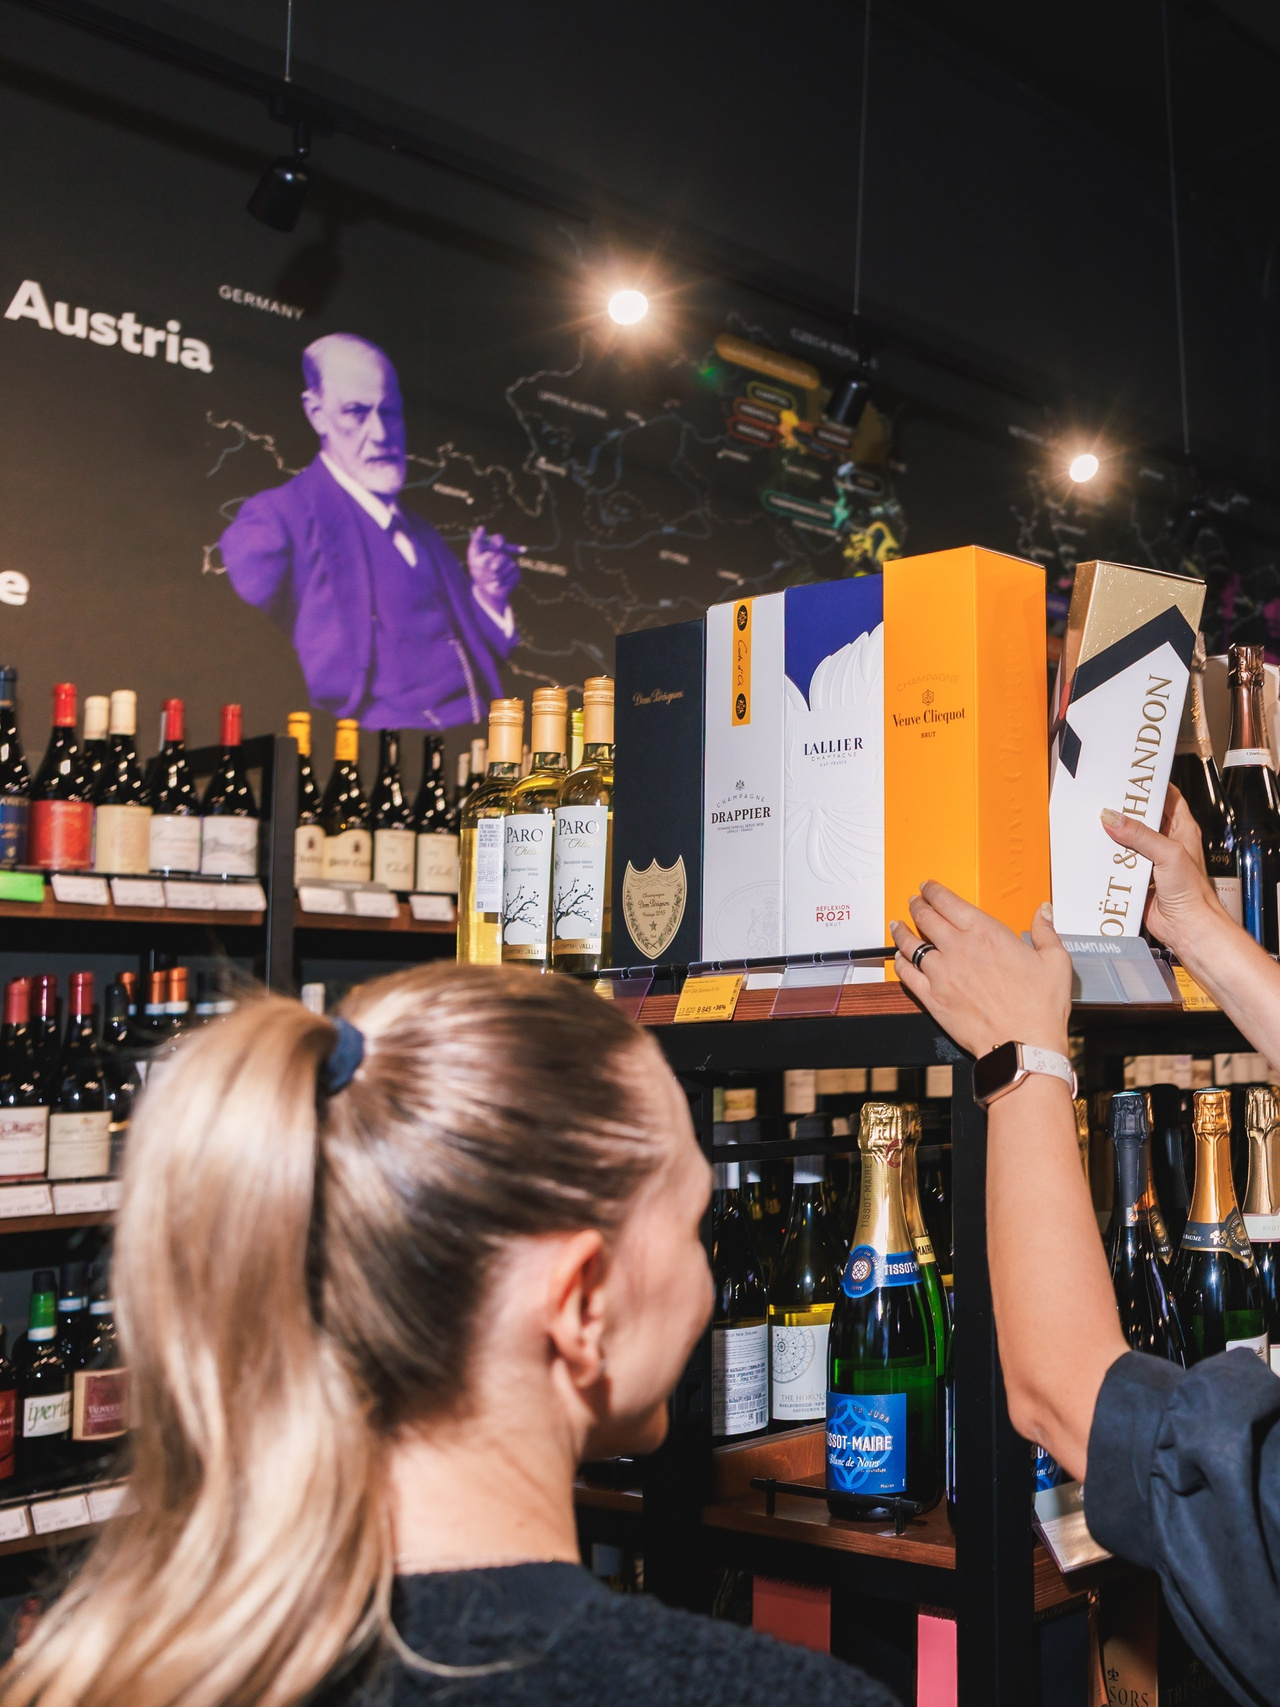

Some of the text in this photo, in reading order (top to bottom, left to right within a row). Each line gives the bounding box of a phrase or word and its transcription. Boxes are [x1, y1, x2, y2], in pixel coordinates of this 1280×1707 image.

[218, 284, 305, 320] GERMANY
[4, 279, 213, 374] Austria
[896, 673, 961, 692] CHAMPAGNE
[893, 707, 966, 728] Veuve Clicquot
[920, 731, 937, 739] BRUT
[804, 737, 864, 756] LALLIER
[717, 793, 765, 809] CHAMPAGNE
[1098, 876, 1133, 937] OËT
[1122, 674, 1173, 818] HANDON
[711, 806, 772, 825] DRAPPIER
[861, 1163, 873, 1228] TISSOT-MAIRE
[828, 1453, 881, 1468] Blanc de Noirs
